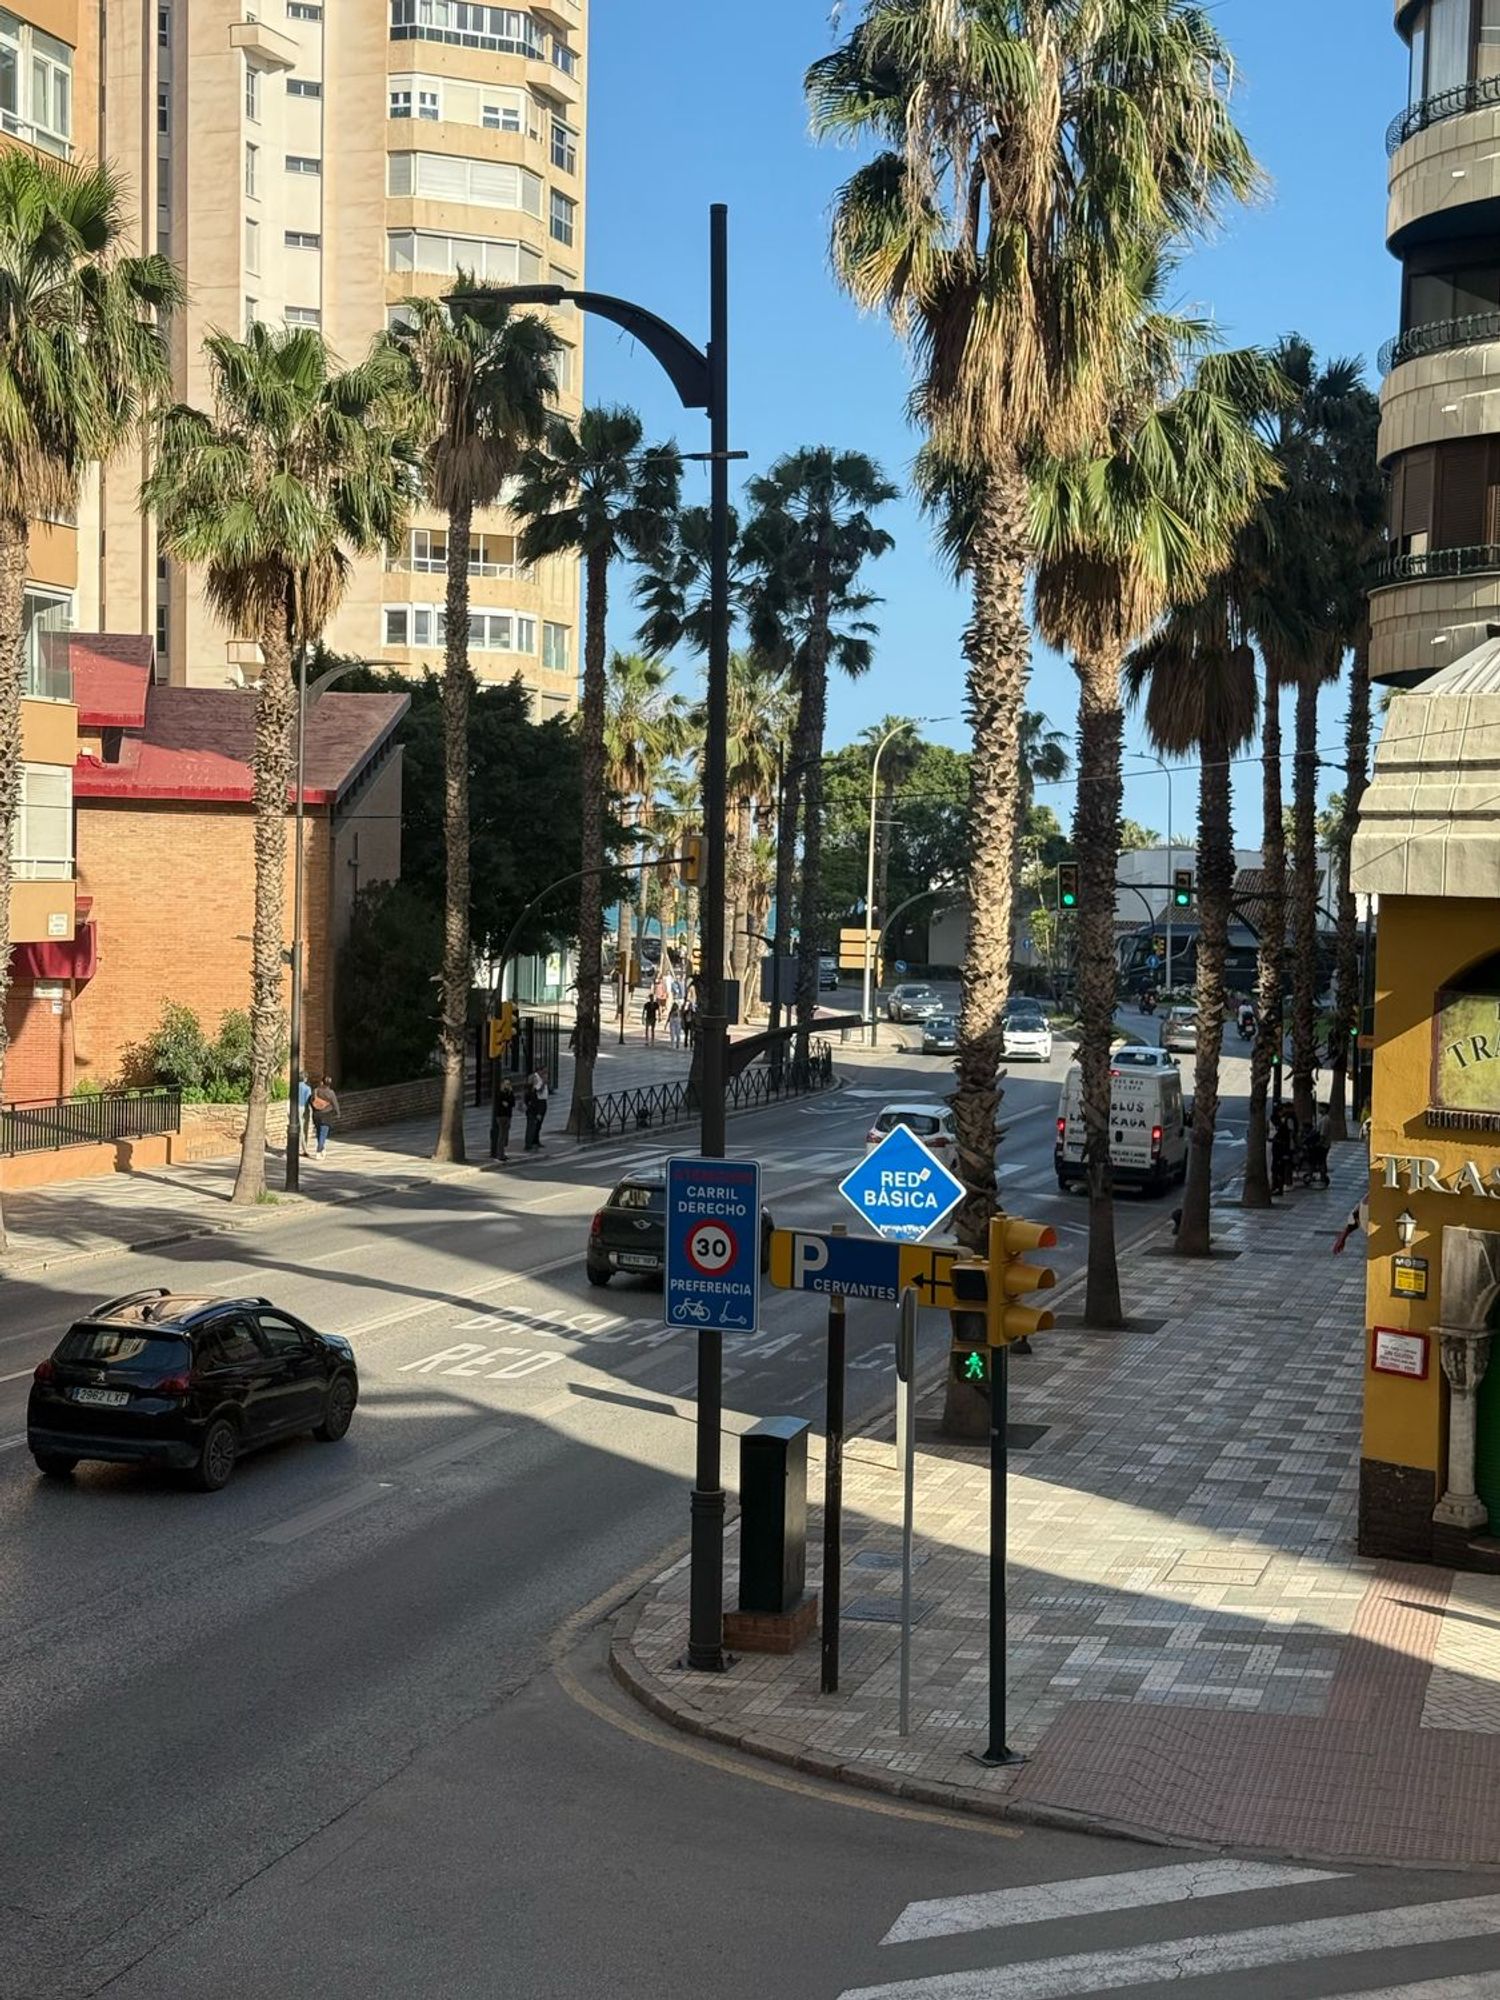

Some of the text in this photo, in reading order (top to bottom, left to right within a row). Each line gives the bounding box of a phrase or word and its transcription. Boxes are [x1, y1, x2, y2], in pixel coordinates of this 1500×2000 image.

[1445, 1034, 1500, 1069] TR
[881, 1170, 920, 1187] RED
[686, 1186, 739, 1200] CARRIL
[864, 1187, 938, 1208] BÁSICA
[678, 1201, 747, 1216] DERECHO
[696, 1238, 727, 1257] 30
[794, 1234, 829, 1288] P
[670, 1278, 752, 1296] PREFERENCIA
[813, 1278, 897, 1300] CERVANTES
[397, 1342, 567, 1379] RED
